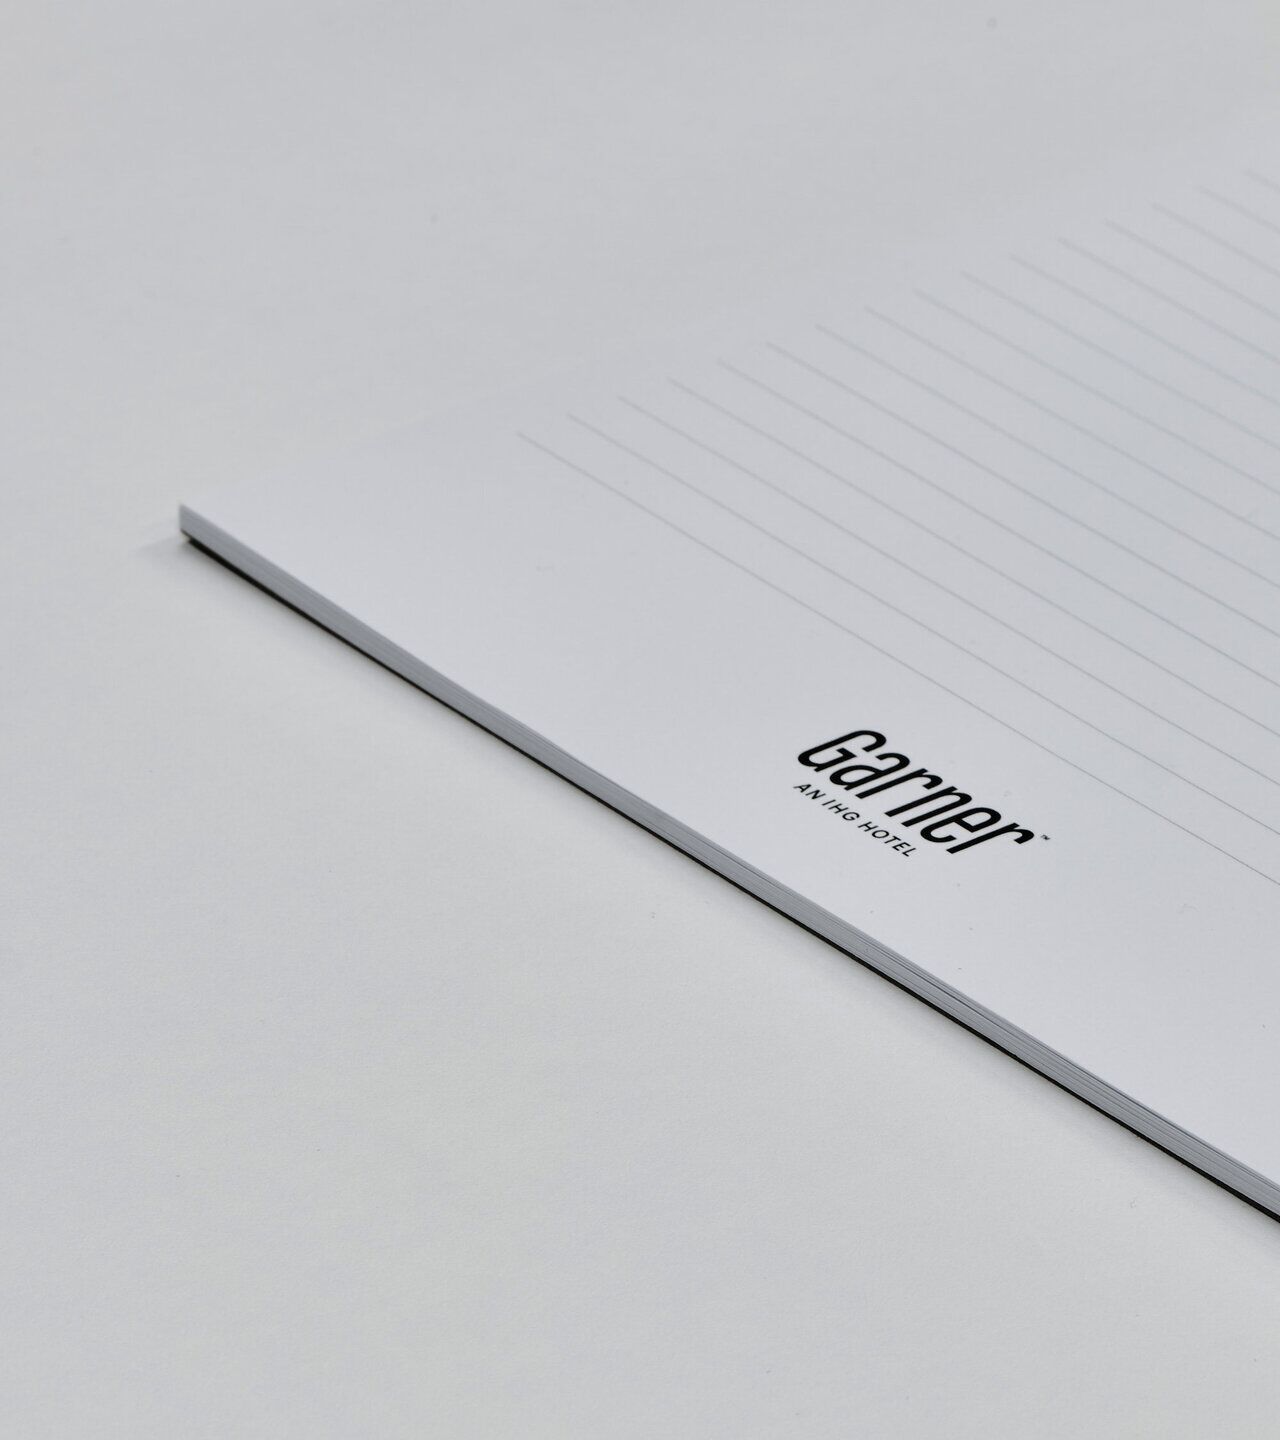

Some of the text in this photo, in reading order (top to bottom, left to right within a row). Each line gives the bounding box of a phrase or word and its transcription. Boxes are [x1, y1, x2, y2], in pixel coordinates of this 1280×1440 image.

[793, 783, 917, 857] AN IHG HOTEL
